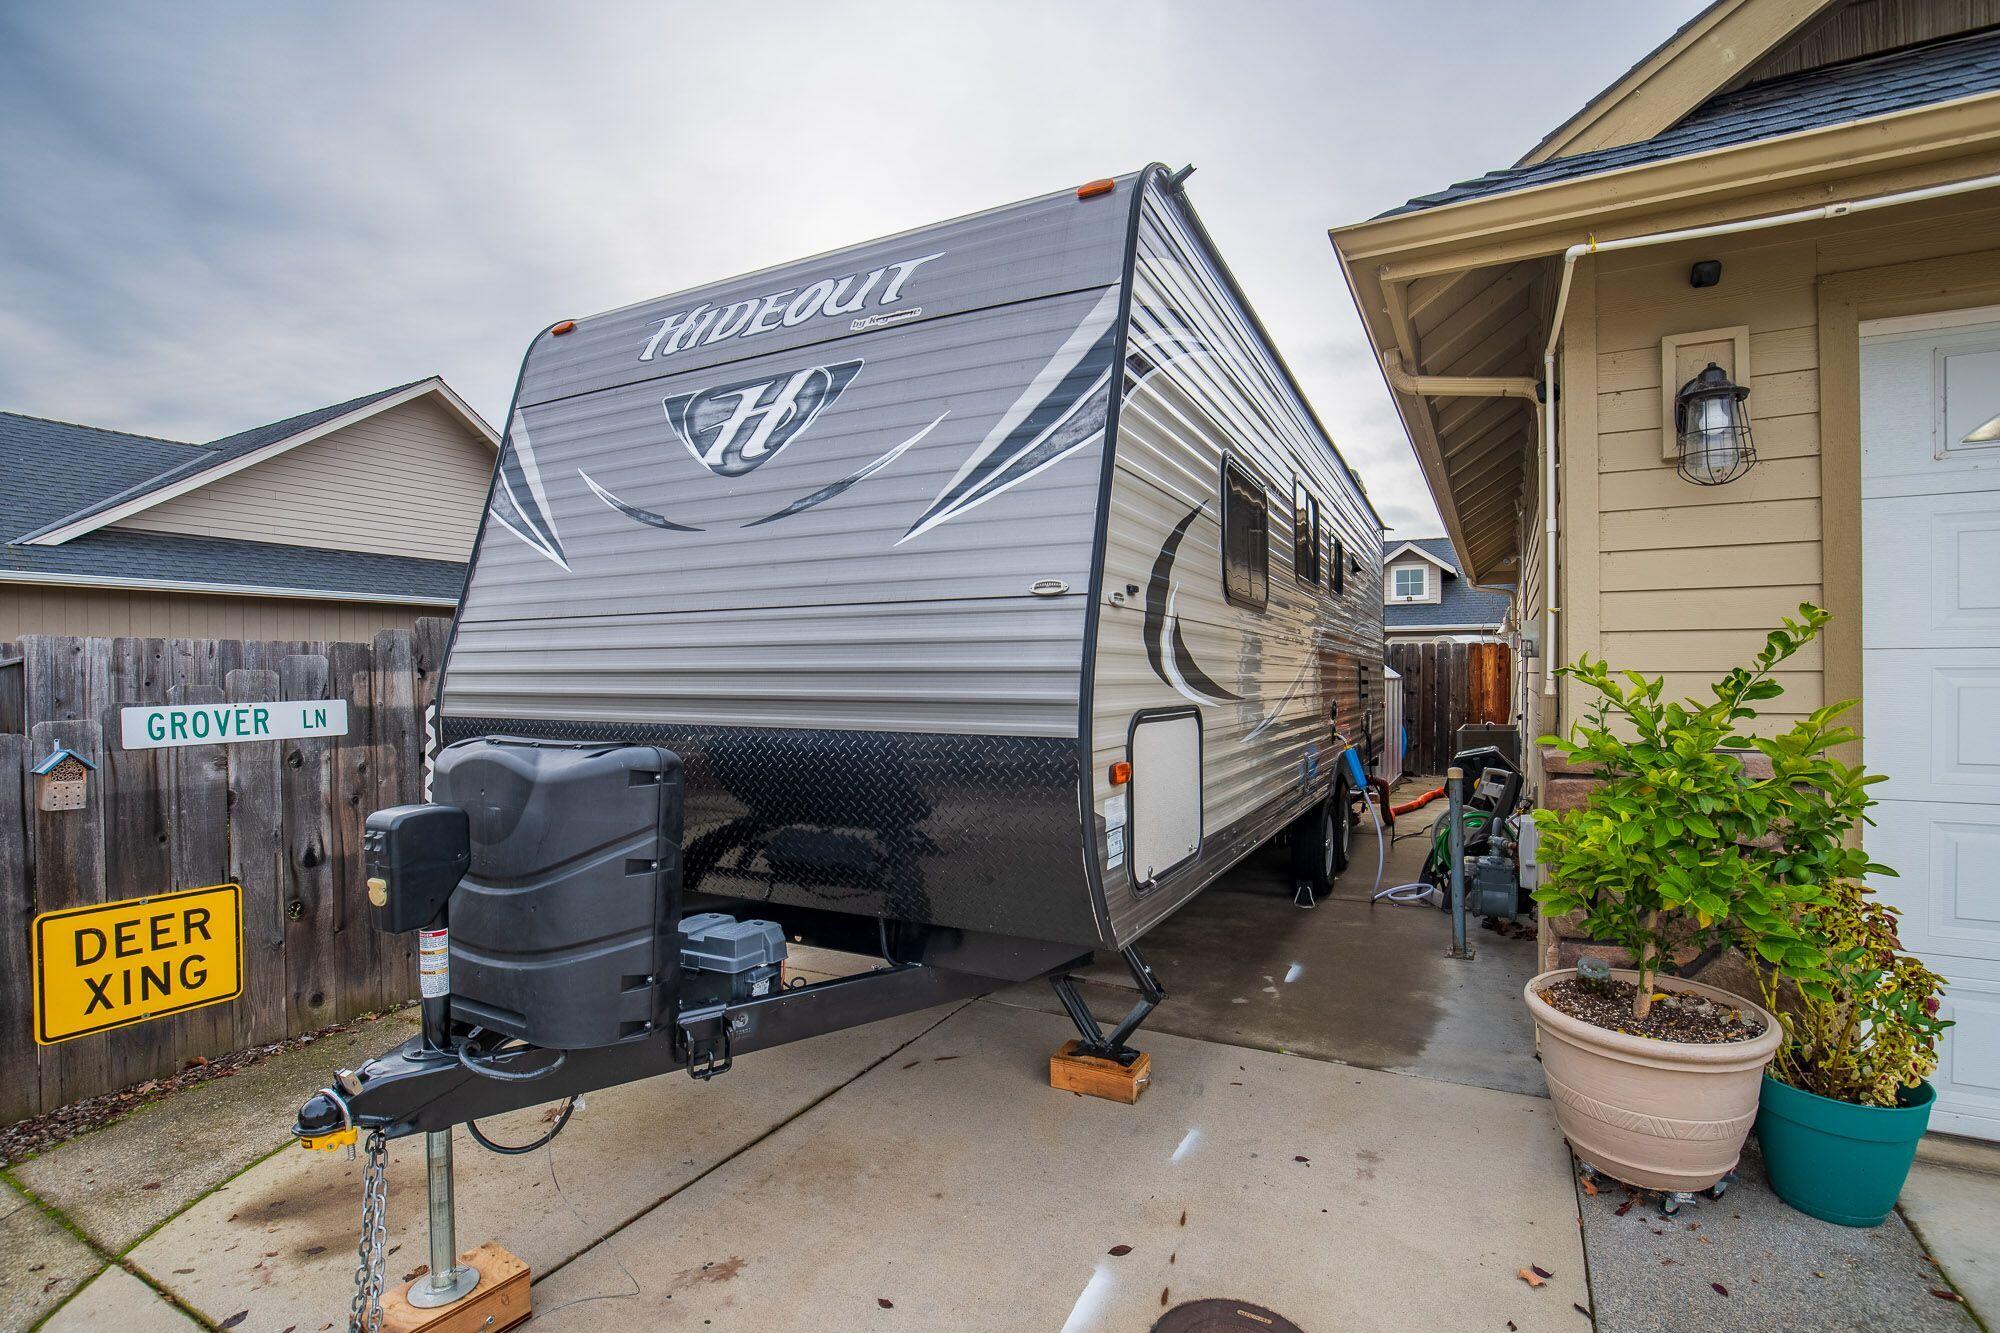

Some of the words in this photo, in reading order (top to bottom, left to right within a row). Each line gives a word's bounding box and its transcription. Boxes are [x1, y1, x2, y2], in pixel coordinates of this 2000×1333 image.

[638, 251, 947, 361] HIDEOUT
[701, 367, 823, 466] H
[147, 708, 270, 741] GROVER
[302, 708, 327, 729] LN
[74, 907, 212, 967] DEER
[83, 954, 208, 1015] XING
